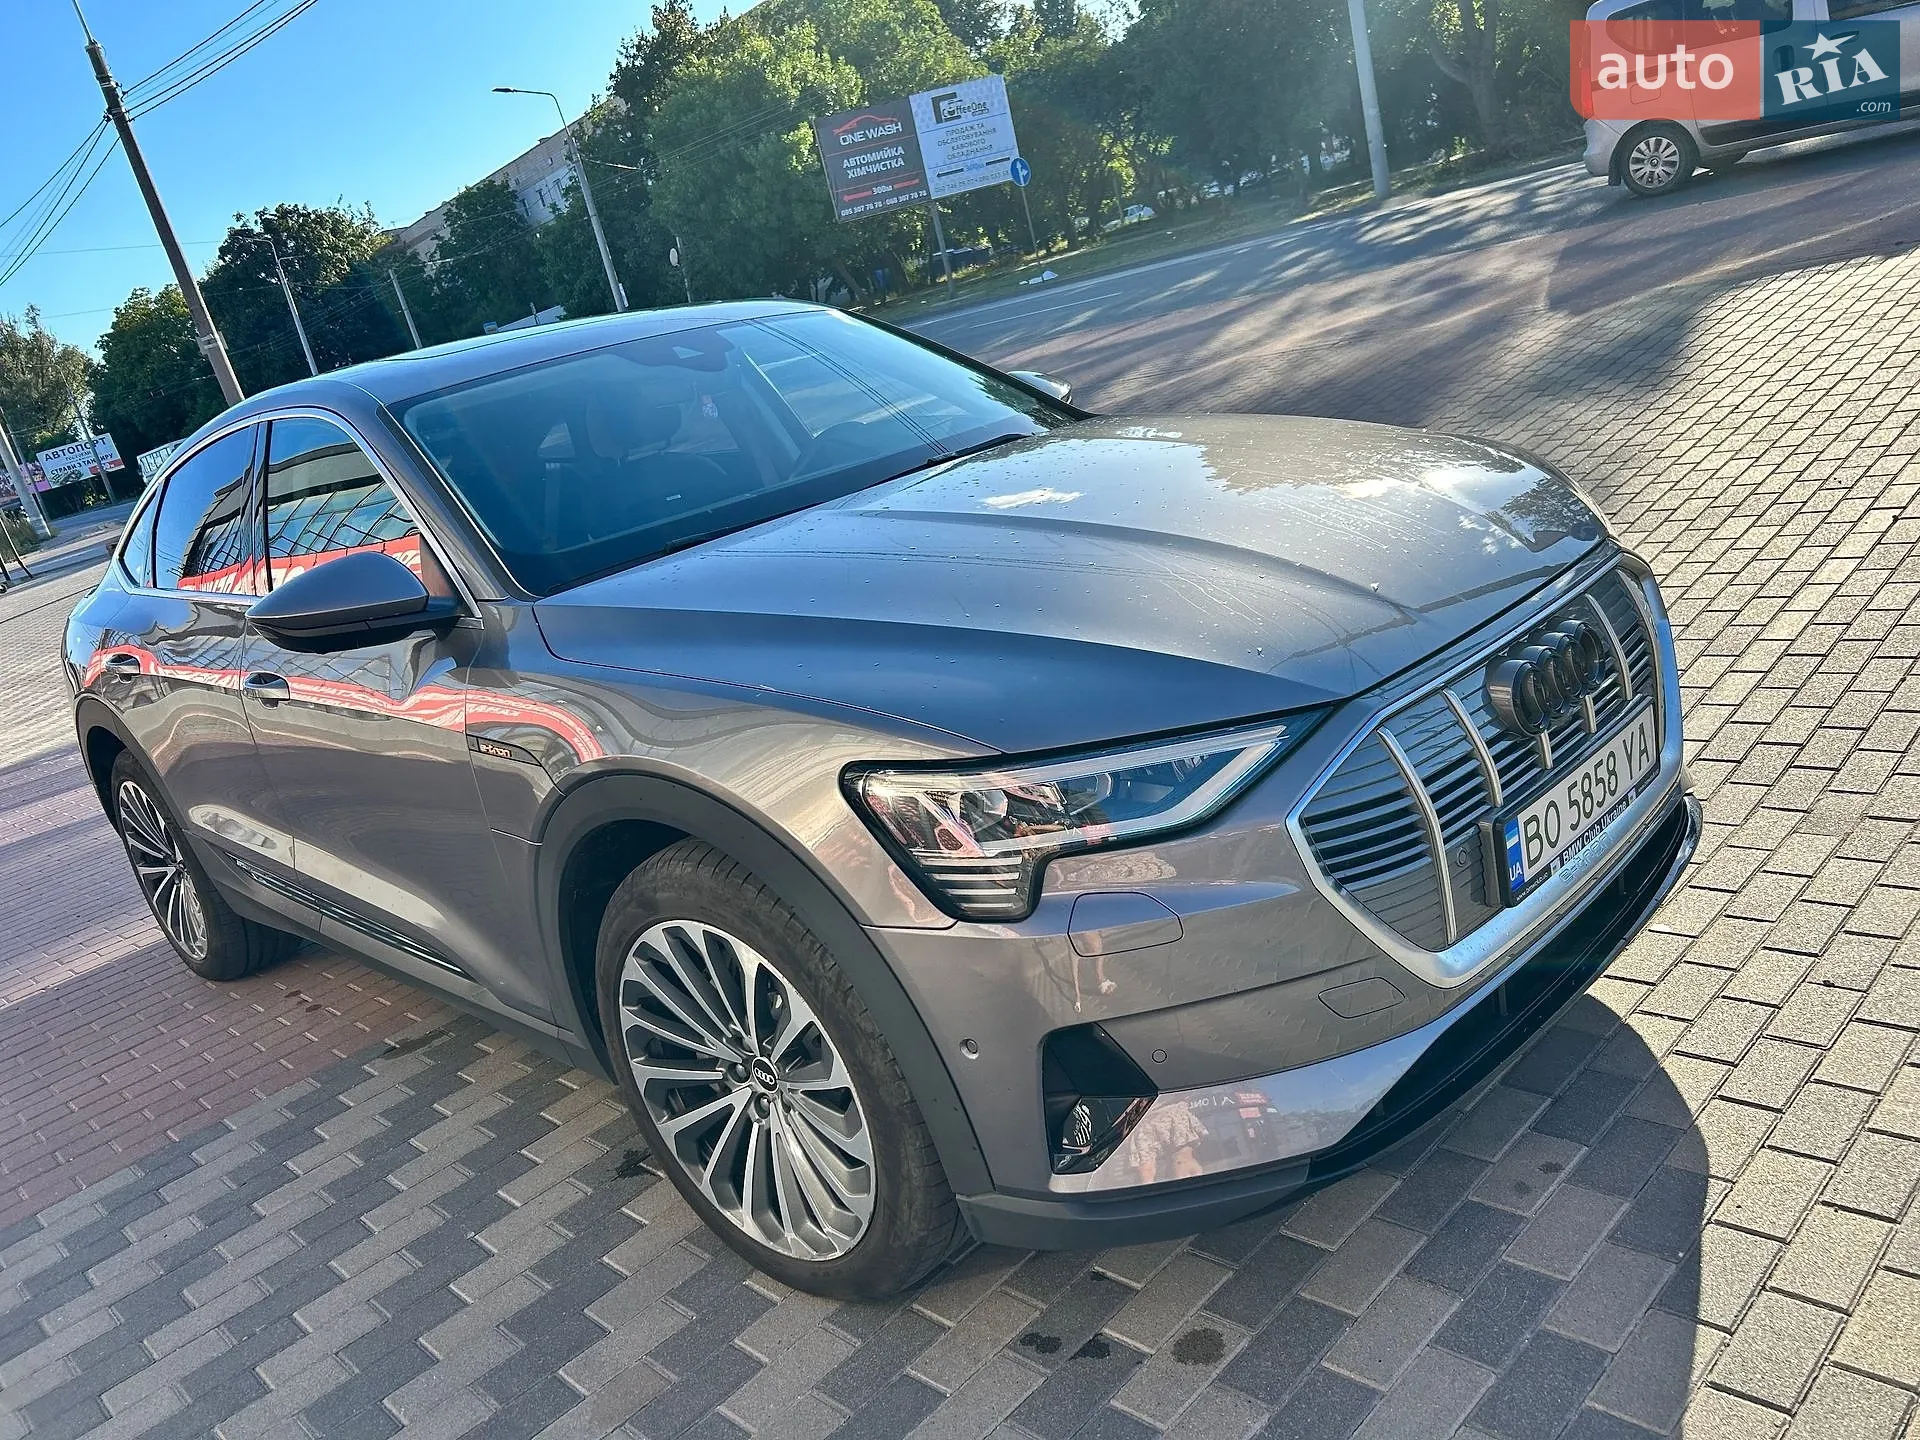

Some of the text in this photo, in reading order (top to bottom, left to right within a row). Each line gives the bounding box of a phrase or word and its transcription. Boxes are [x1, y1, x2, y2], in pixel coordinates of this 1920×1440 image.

[839, 122, 902, 146] ONE WASH
[946, 126, 974, 136] ПРОДАЖ
[842, 146, 905, 170] АВТОМИЙКА
[847, 157, 905, 179] ХІМЧИСТКА
[83, 453, 113, 466] ТАНИРУ
[480, 743, 512, 757] e-tron
[1523, 721, 1650, 870] BO 5858 YA
[1562, 799, 1627, 864] BMW Club Ukraine
[1509, 862, 1523, 880] UA
